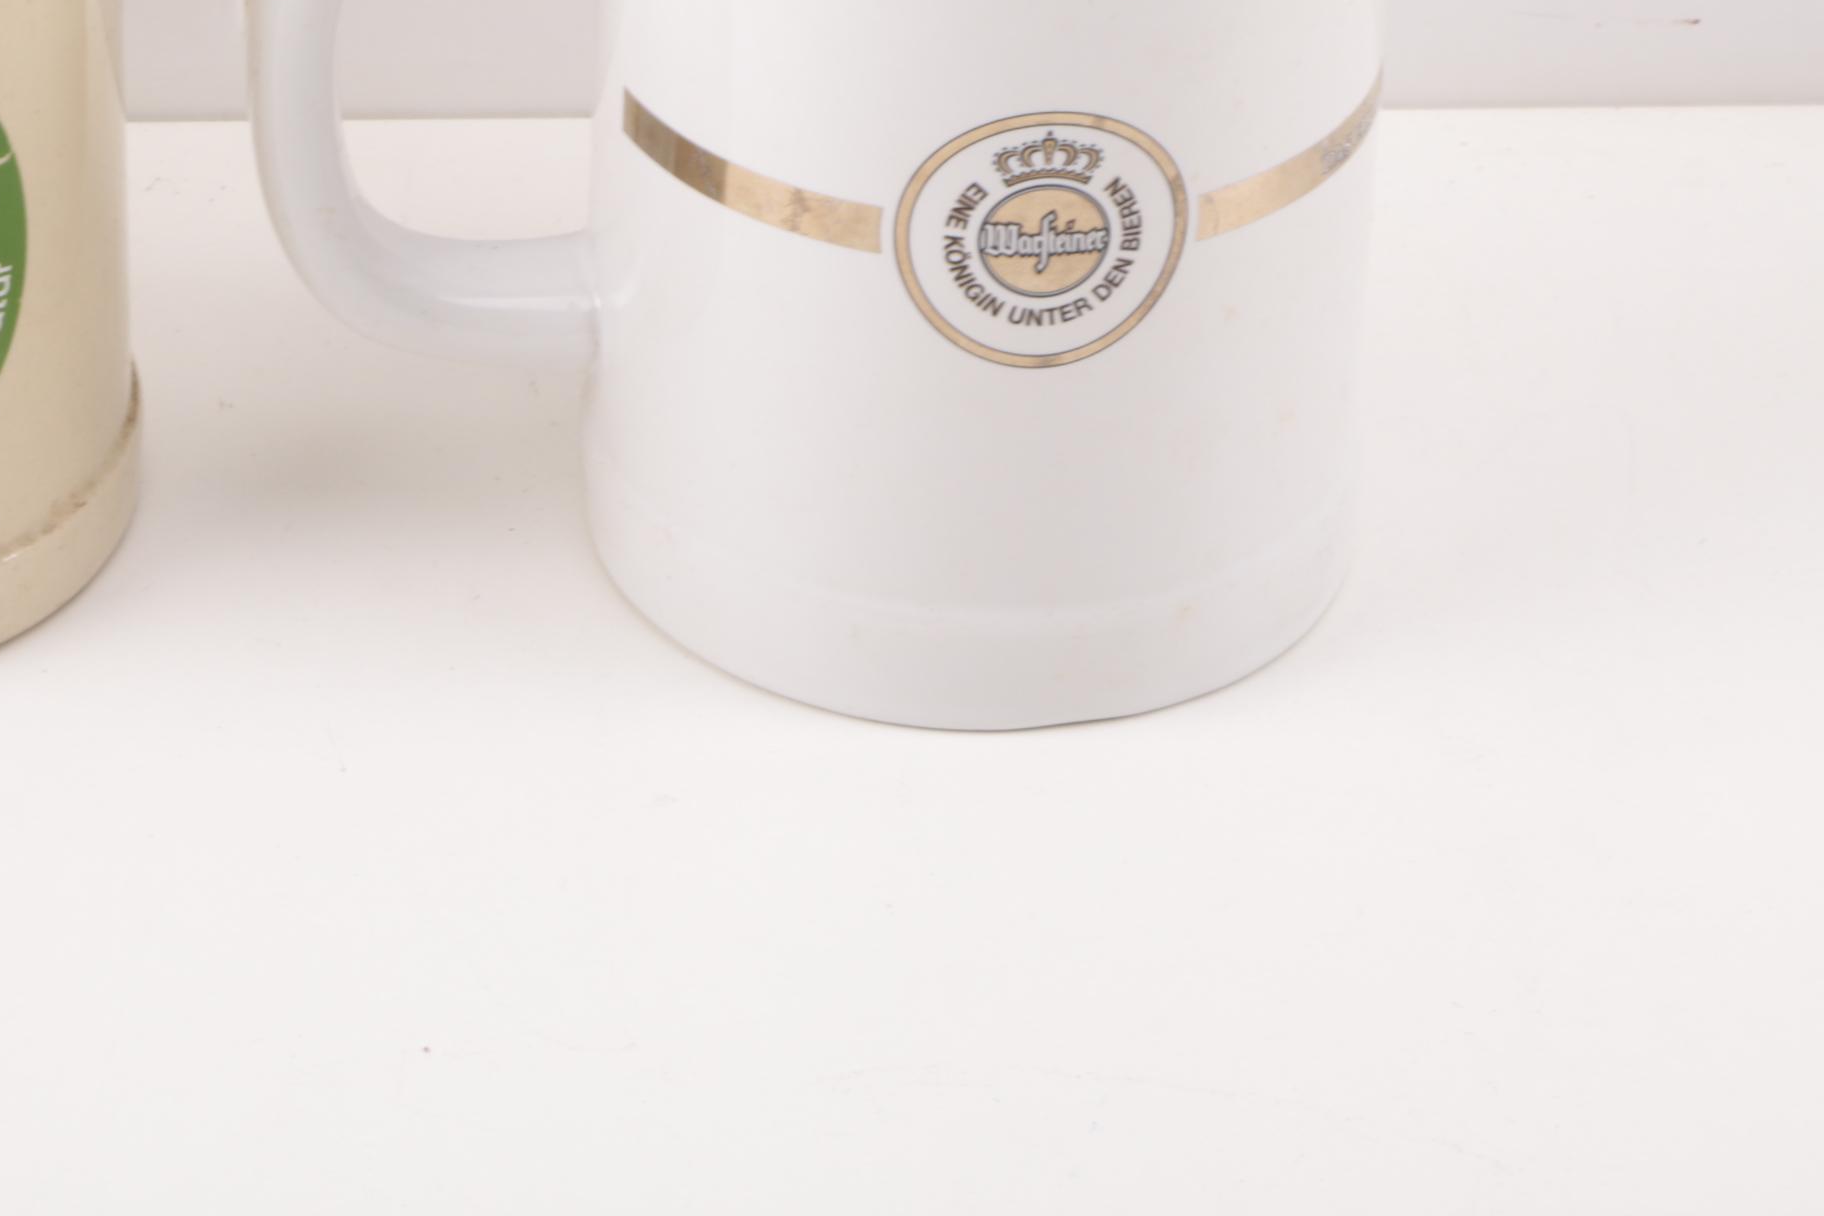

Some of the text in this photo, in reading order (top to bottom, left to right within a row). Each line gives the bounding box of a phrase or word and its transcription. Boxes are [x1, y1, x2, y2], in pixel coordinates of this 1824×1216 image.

[943, 175, 1143, 327] EINE KÖNIGIN UNTER DEN BIEREN
